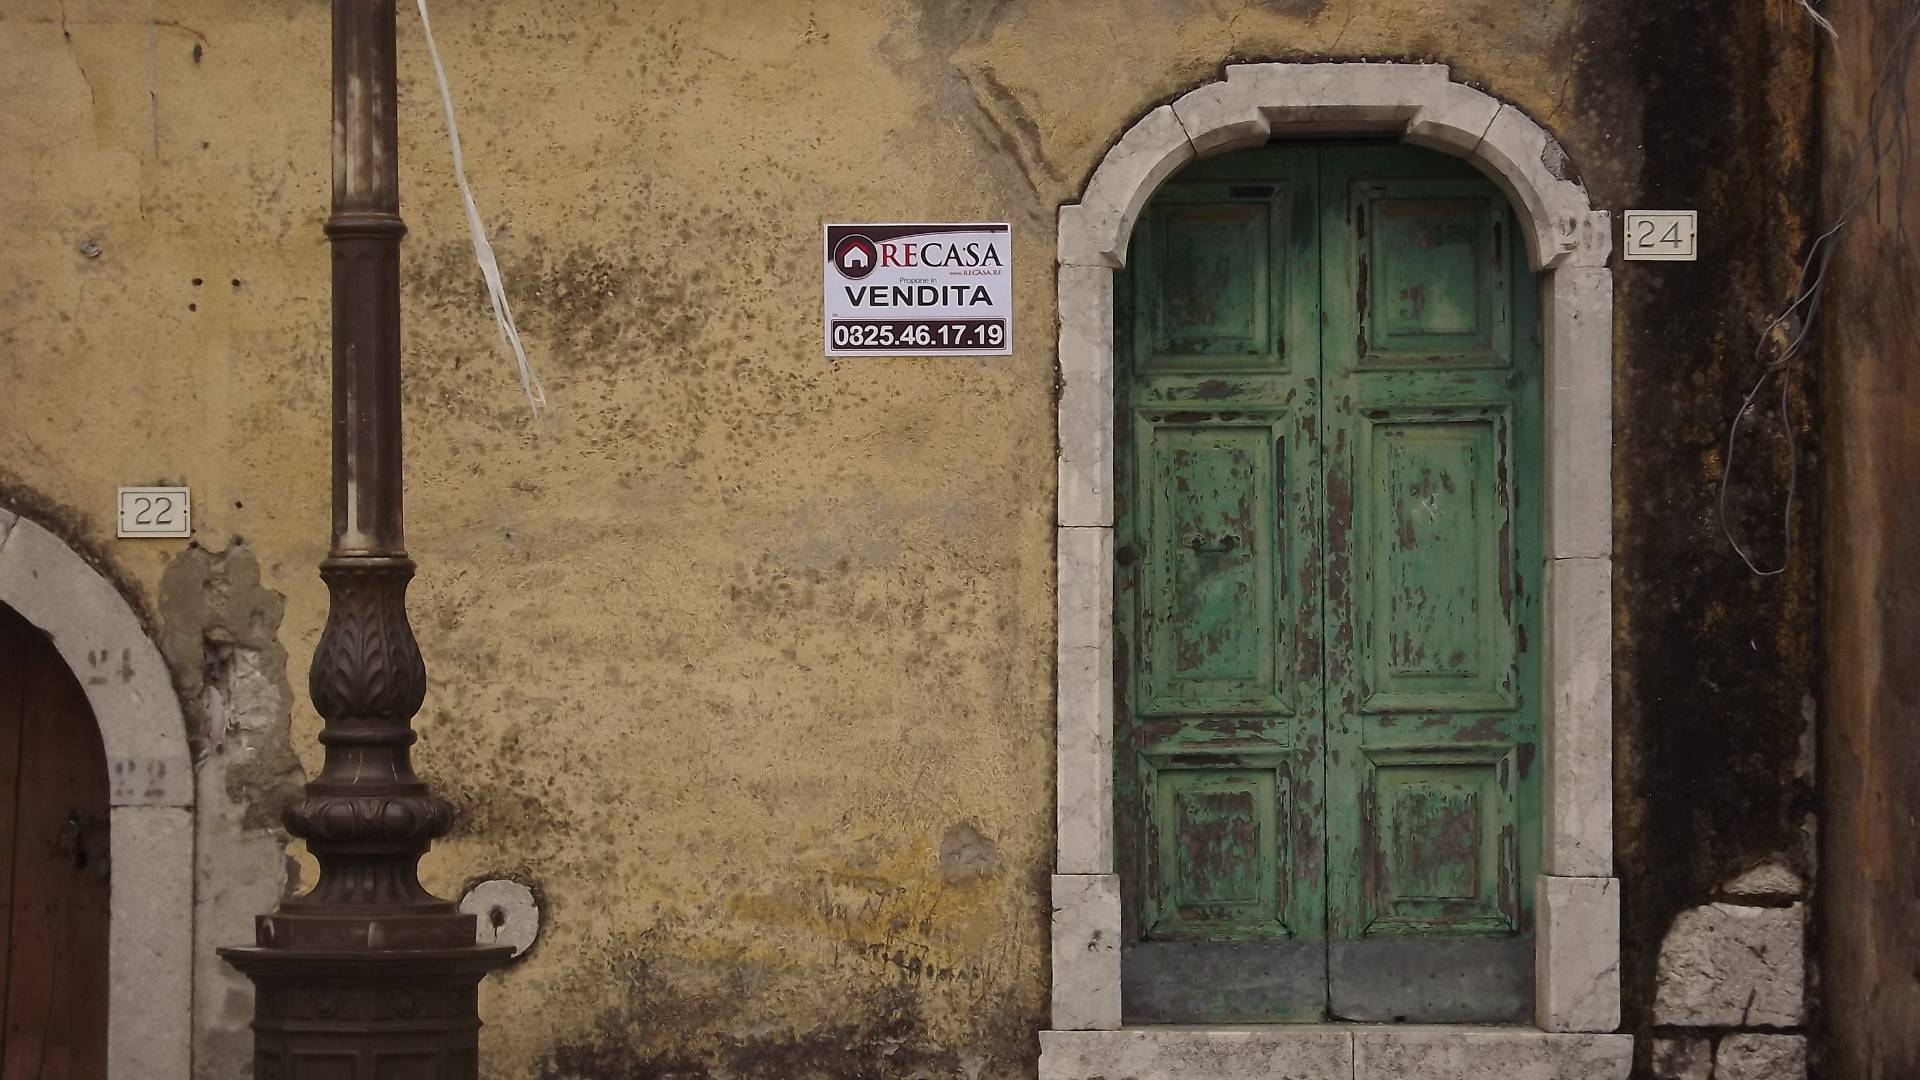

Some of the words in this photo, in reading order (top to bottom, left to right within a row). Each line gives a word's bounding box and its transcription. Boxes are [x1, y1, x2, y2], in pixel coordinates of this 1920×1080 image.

[1638, 220, 1683, 249] 24
[880, 242, 1004, 268] RECASA
[899, 277, 929, 285] Propone
[845, 285, 993, 307] VENDITA
[134, 497, 172, 525] 22
